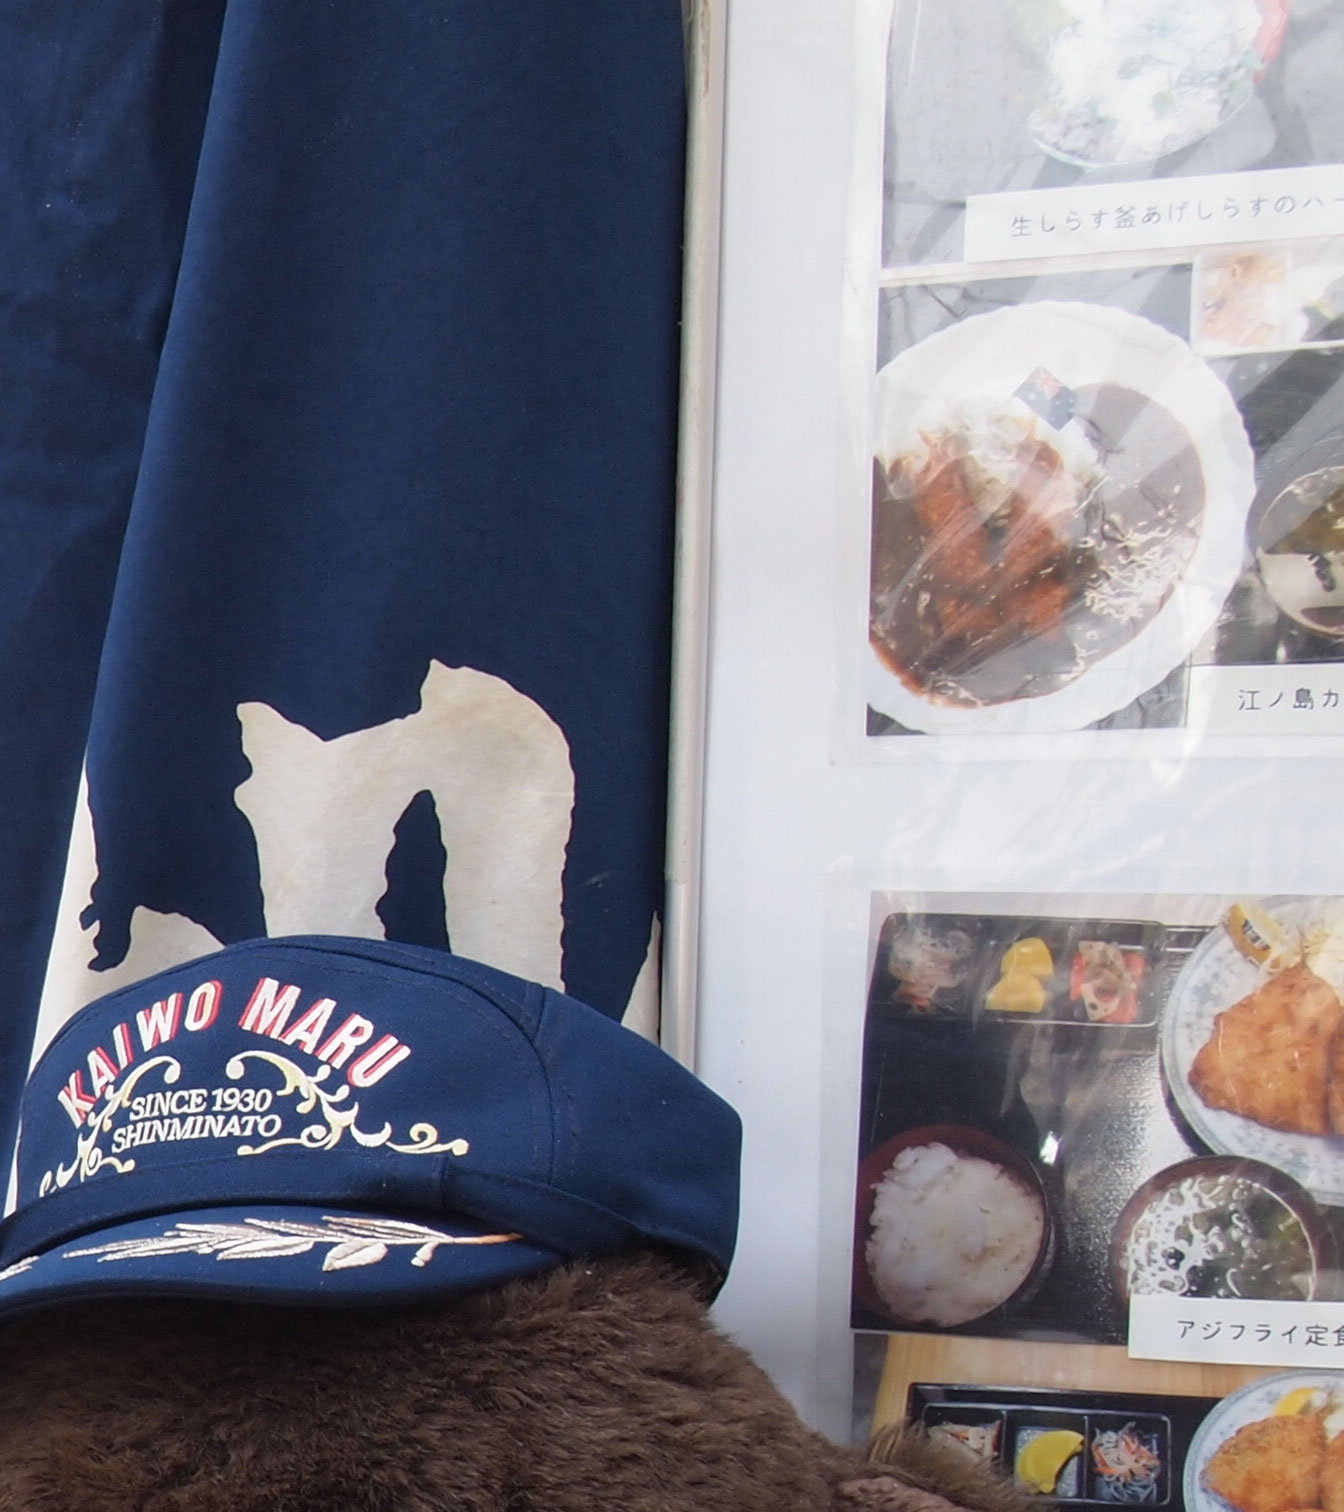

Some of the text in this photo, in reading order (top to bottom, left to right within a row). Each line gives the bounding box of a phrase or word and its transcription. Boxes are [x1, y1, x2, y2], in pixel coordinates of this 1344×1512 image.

[1238, 686, 1340, 711] 江ノ島カ
[57, 976, 411, 1129] KAIWO MARU
[129, 1086, 273, 1122] SINCE 1930
[112, 1113, 282, 1154] SHINMINATO
